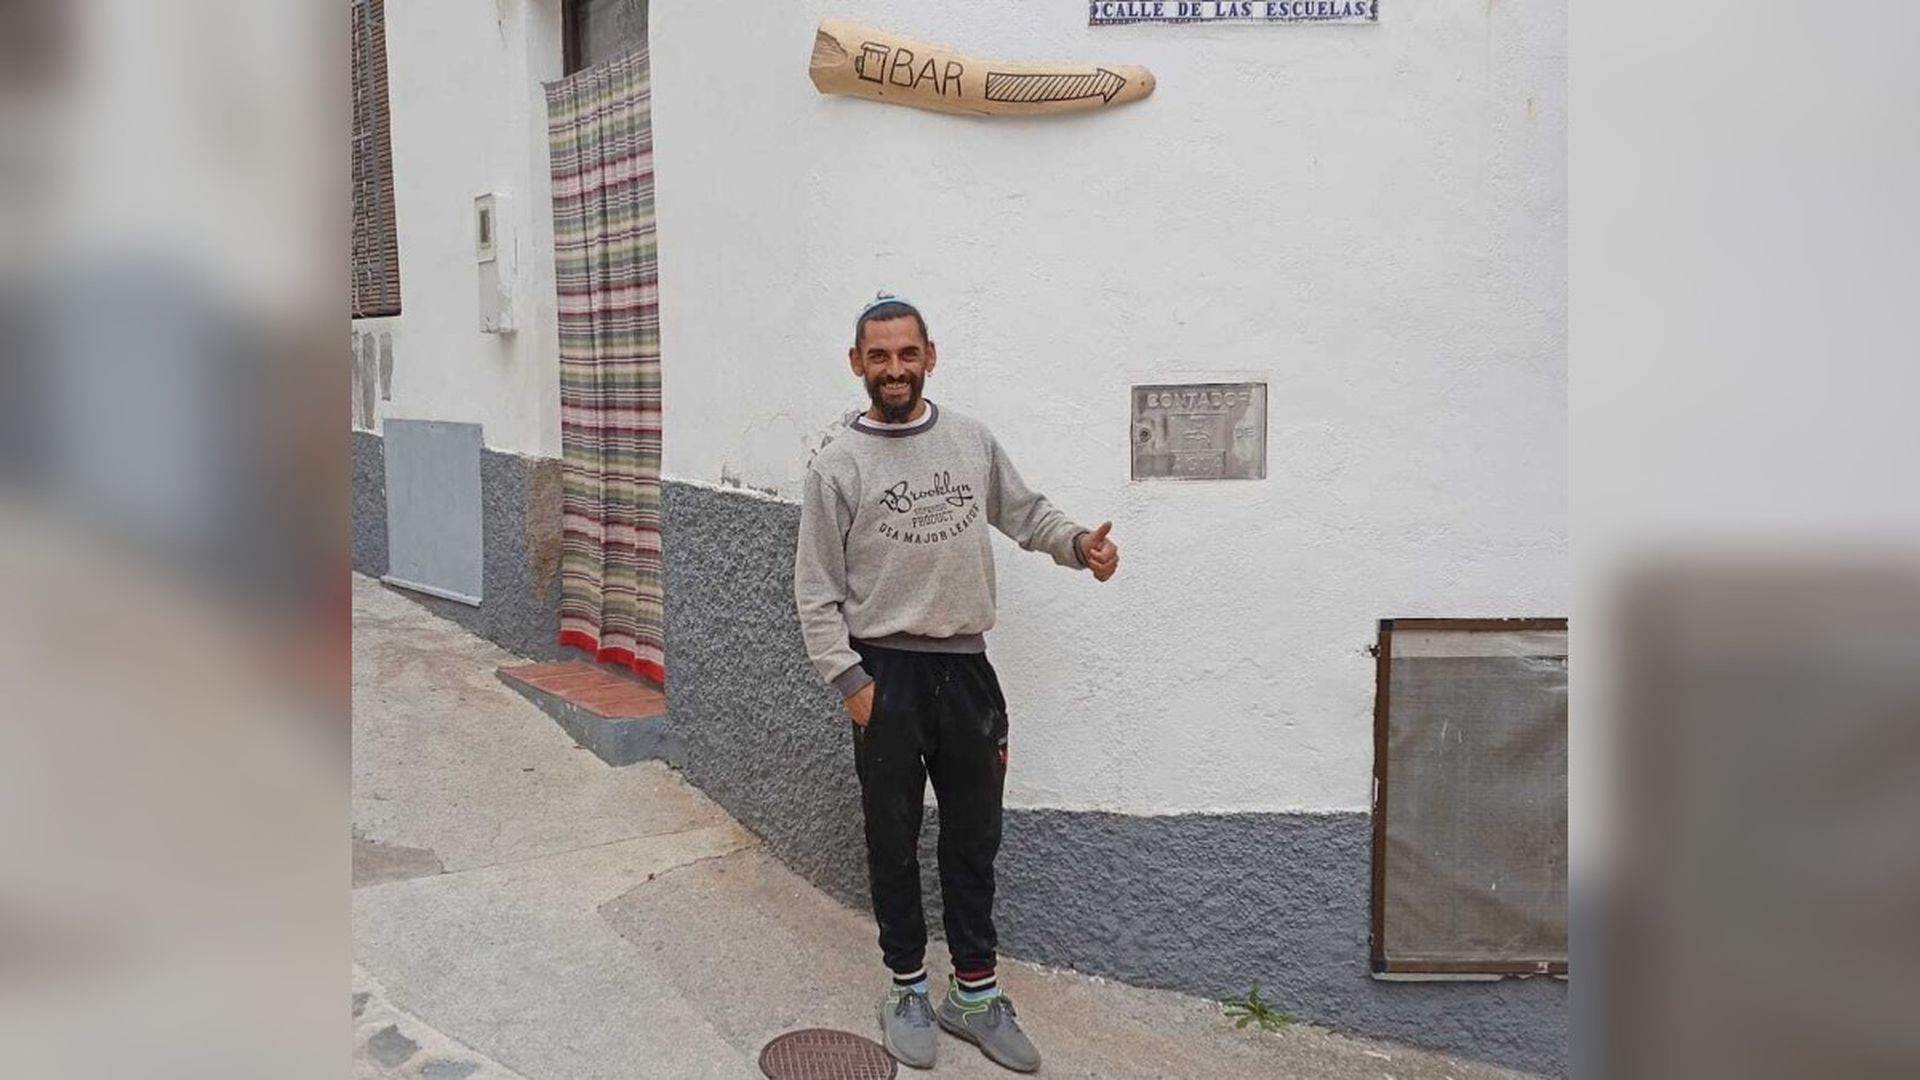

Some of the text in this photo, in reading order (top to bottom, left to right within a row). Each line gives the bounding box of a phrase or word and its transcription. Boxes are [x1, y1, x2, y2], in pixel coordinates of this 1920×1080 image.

[1103, 1, 1365, 17] CALLE DE LAS ESCUELAS
[889, 48, 964, 97] BAR
[880, 470, 974, 513] Brooklyn
[911, 510, 955, 528] PRODUCT
[879, 523, 899, 541] USA
[903, 531, 948, 545] MAJOR
